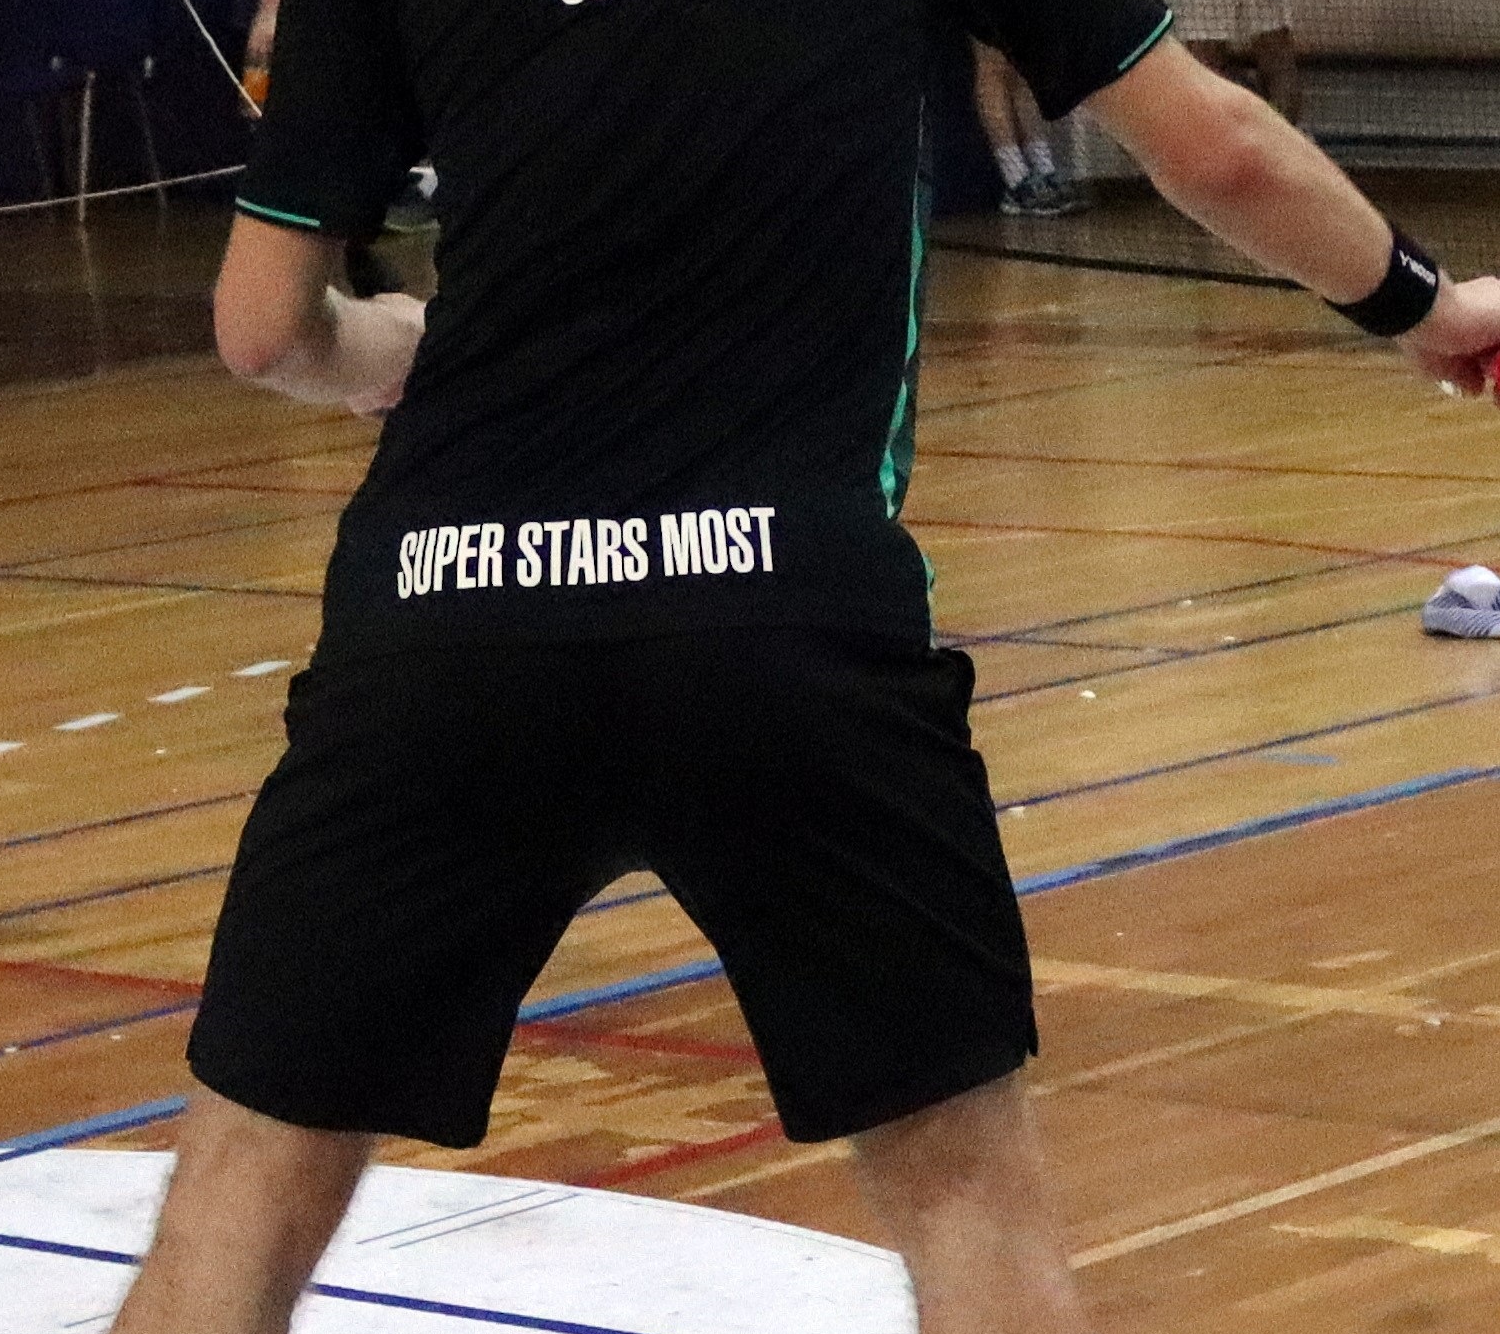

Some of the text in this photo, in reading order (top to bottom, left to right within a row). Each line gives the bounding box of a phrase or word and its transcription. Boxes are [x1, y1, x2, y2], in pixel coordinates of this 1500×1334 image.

[396, 506, 776, 600] SUPER STARS MOST
